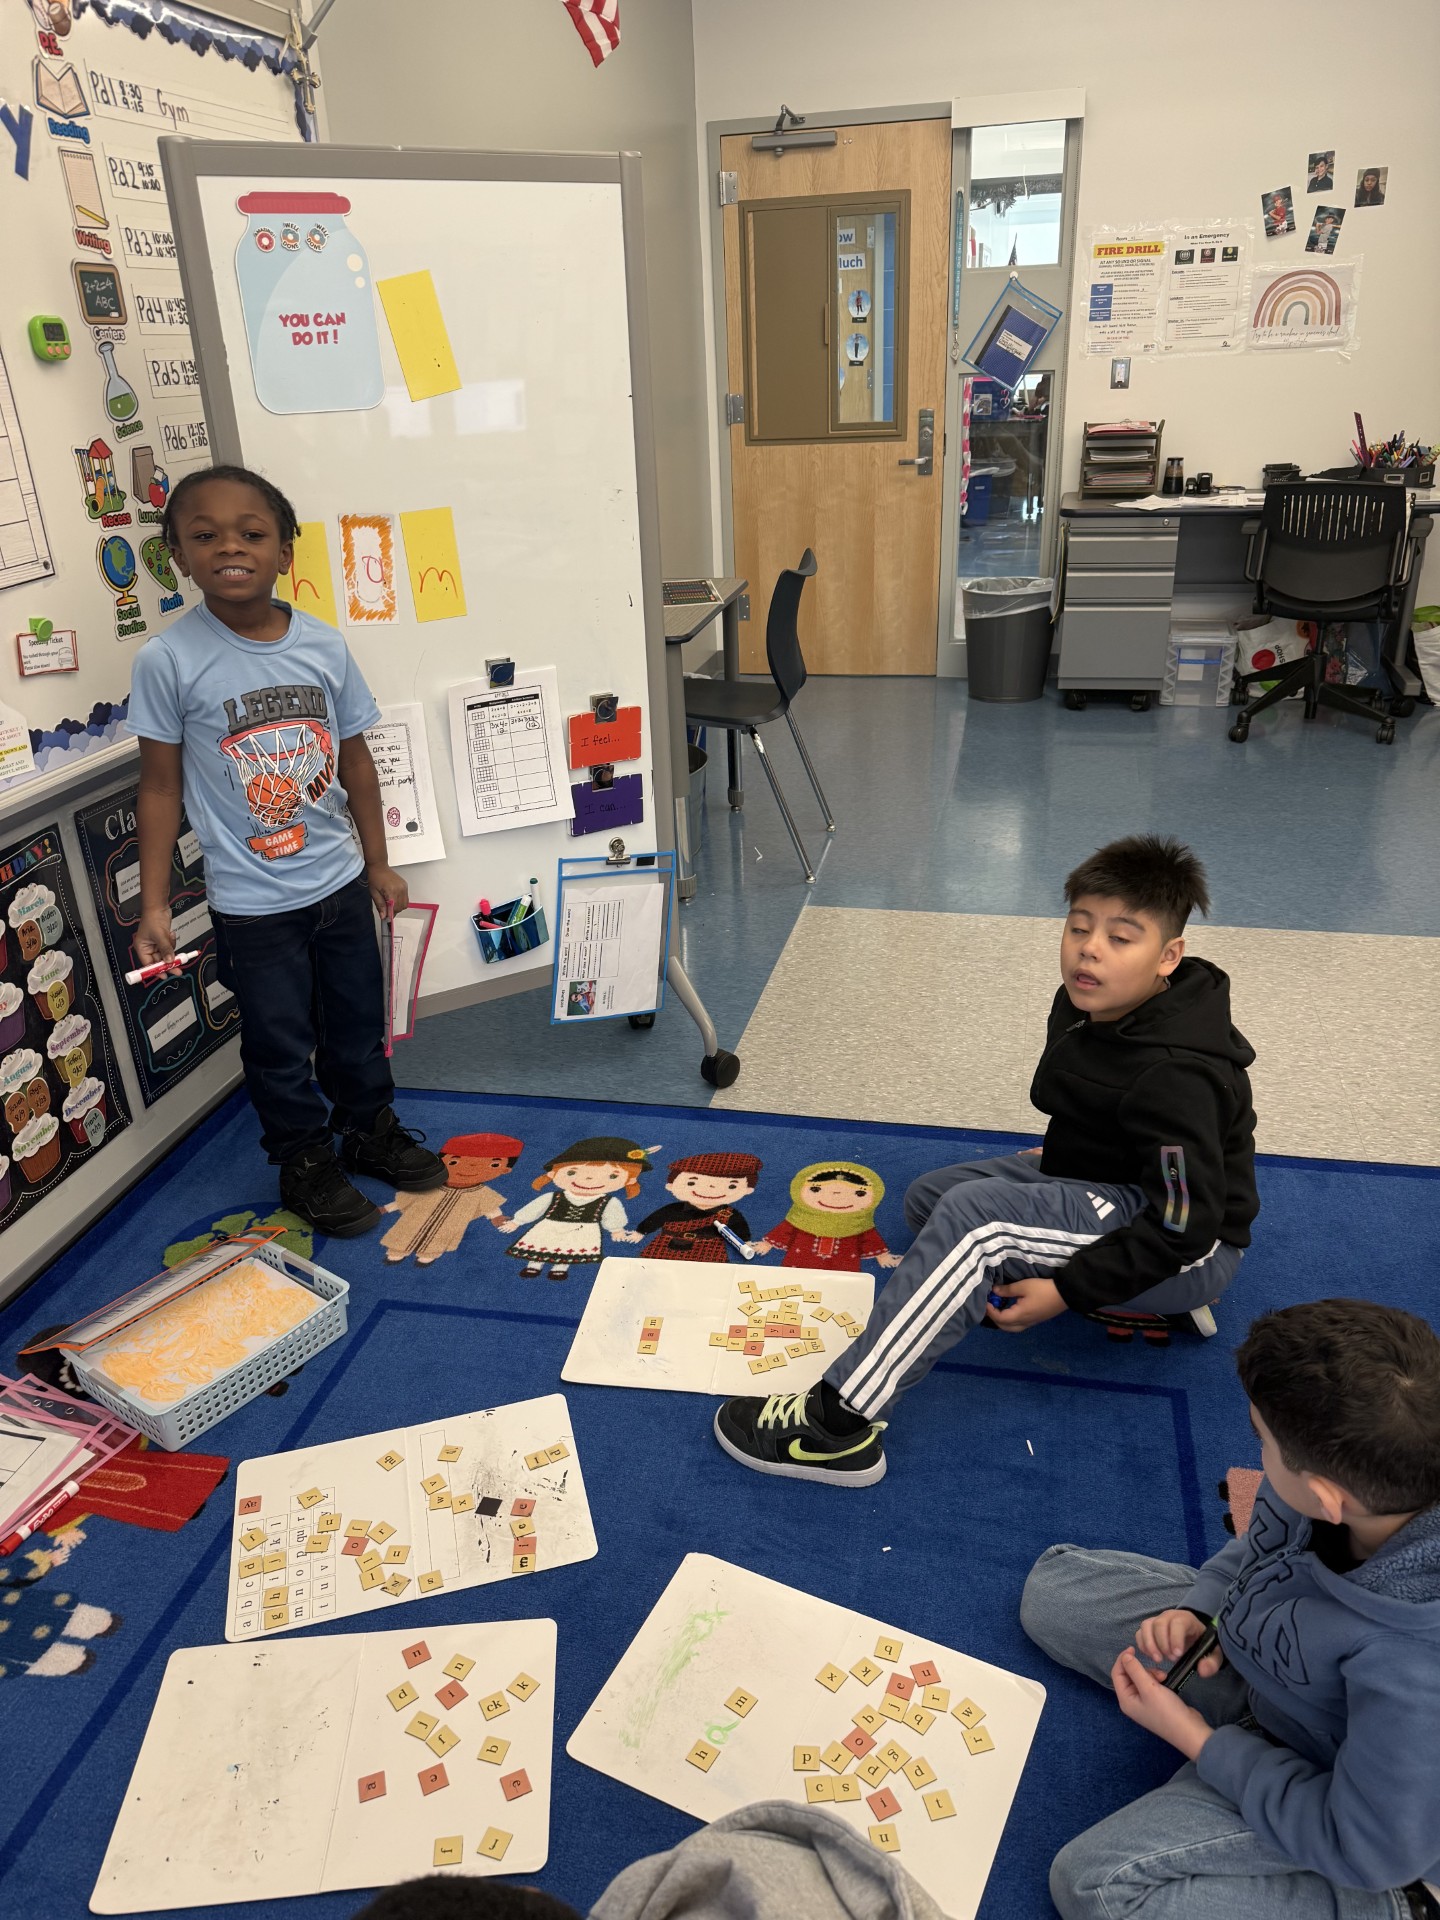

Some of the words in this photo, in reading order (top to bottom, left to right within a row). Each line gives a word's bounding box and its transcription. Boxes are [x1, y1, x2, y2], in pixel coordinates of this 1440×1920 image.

[38, 31, 64, 56] P.E.
[119, 80, 142, 100] 8:30
[122, 97, 144, 113] 9:15
[157, 89, 189, 130] Gym
[48, 118, 90, 144] Reading
[109, 158, 140, 190] Pd2
[138, 162, 154, 177] 9:15
[142, 179, 161, 191] 10:00
[75, 228, 112, 254] Writing
[125, 227, 152, 256] Pd3
[152, 232, 173, 244] 10:00
[282, 240, 298, 249] DONE
[307, 238, 321, 250] DONE
[156, 246, 176, 257] 10:45
[1097, 246, 1123, 256] FIRE
[1126, 245, 1160, 254] DRILL
[96, 297, 116, 310] ABC
[136, 296, 165, 323] Pd4
[166, 298, 186, 312] 10:45
[169, 312, 189, 325] 11:30
[279, 313, 310, 327] YOU
[313, 312, 346, 326] CAN
[93, 327, 125, 341] Centers
[292, 332, 313, 345] DO
[152, 361, 180, 387] Pd5
[116, 420, 144, 439] Science
[188, 422, 206, 437] 12:15
[164, 424, 187, 450] Pd6
[192, 435, 208, 448] 1:00
[102, 512, 132, 528] Recess
[290, 558, 320, 602] h
[362, 556, 385, 584] a
[419, 568, 458, 599] m
[160, 592, 184, 613] Math
[117, 604, 141, 621] Social
[117, 620, 147, 637] Studies
[1275, 645, 1285, 663] SHOP
[223, 685, 327, 736] LEGEND
[581, 738, 589, 747] I
[389, 757, 400, 765] you
[305, 754, 335, 804] MVP
[380, 776, 394, 787] onut
[585, 803, 595, 814] I
[265, 830, 294, 846] GAME
[273, 842, 299, 857] TIME
[17, 897, 45, 916] March
[40, 968, 60, 983] June
[50, 1023, 88, 1053] September
[4, 1061, 33, 1086] August
[64, 1084, 102, 1117] December
[14, 1121, 57, 1156] November
[270, 1538, 281, 1546] k
[296, 1530, 307, 1542] qu
[241, 1600, 252, 1609] b
[295, 1606, 303, 1618] m
[827, 1672, 837, 1682] x
[862, 1666, 871, 1677] k
[516, 1681, 529, 1690] k
[486, 1700, 503, 1712] ck
[735, 1696, 748, 1708] m
[962, 1707, 972, 1717] w
[695, 1750, 708, 1760] h
[887, 1749, 899, 1762] g
[914, 1765, 925, 1776] d
[816, 1784, 823, 1792] c
[842, 1784, 850, 1792] s
[880, 1798, 887, 1808] i
[936, 1799, 942, 1808] t
